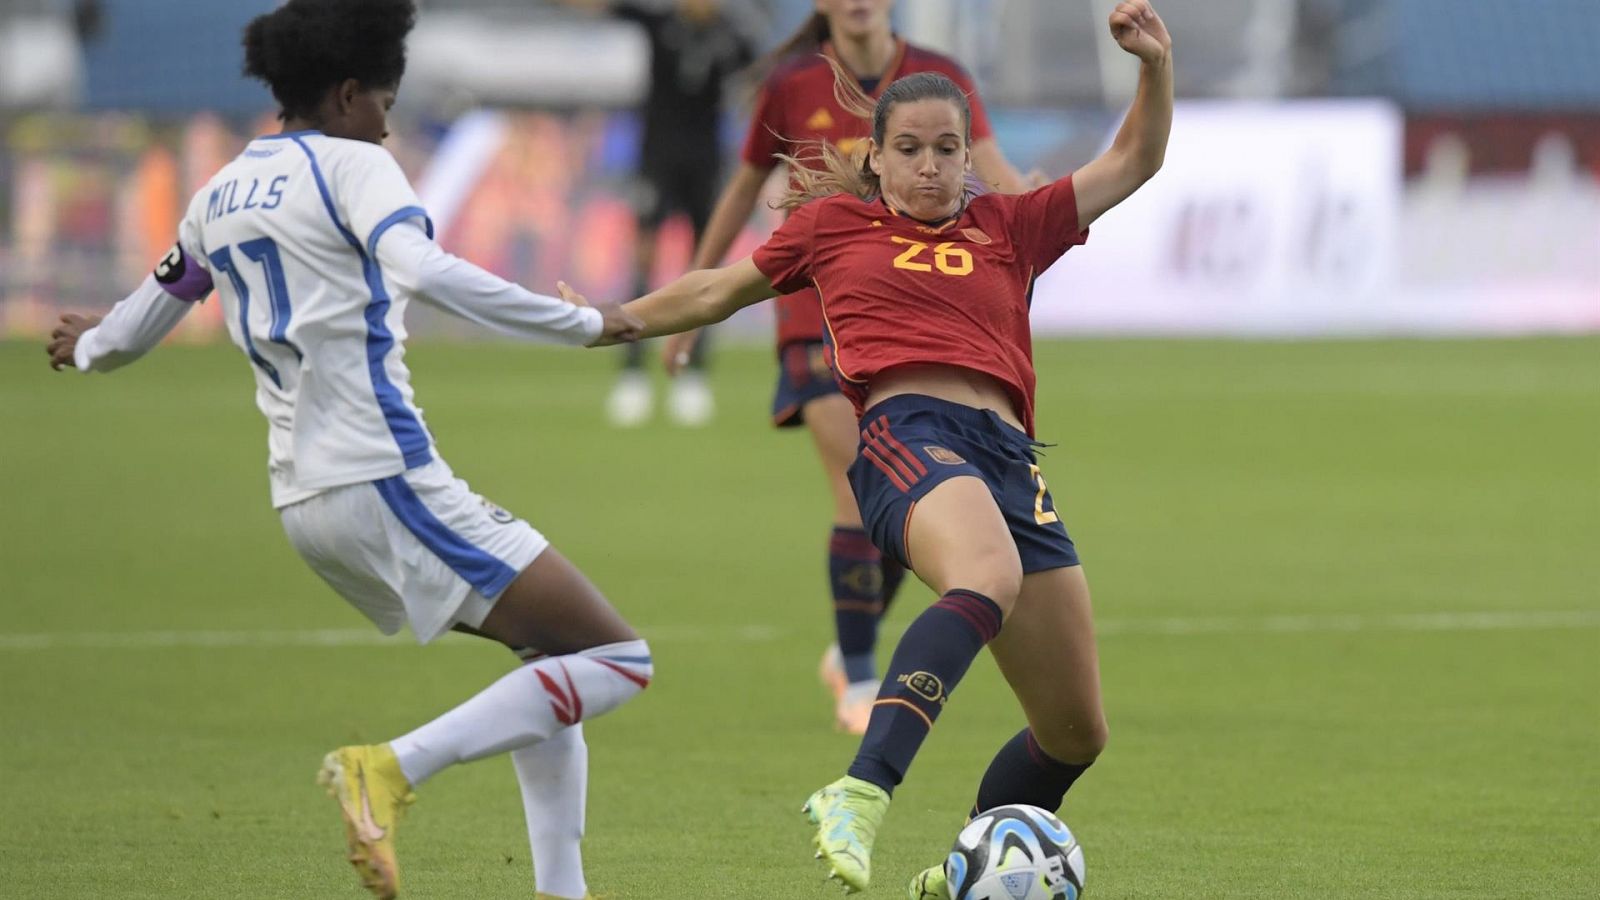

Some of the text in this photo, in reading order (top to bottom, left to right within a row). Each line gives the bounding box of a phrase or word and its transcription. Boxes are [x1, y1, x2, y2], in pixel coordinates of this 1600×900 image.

[206, 175, 288, 224] MILLS
[156, 245, 181, 277] C
[891, 235, 974, 276] 26
[1027, 463, 1060, 526] 2
